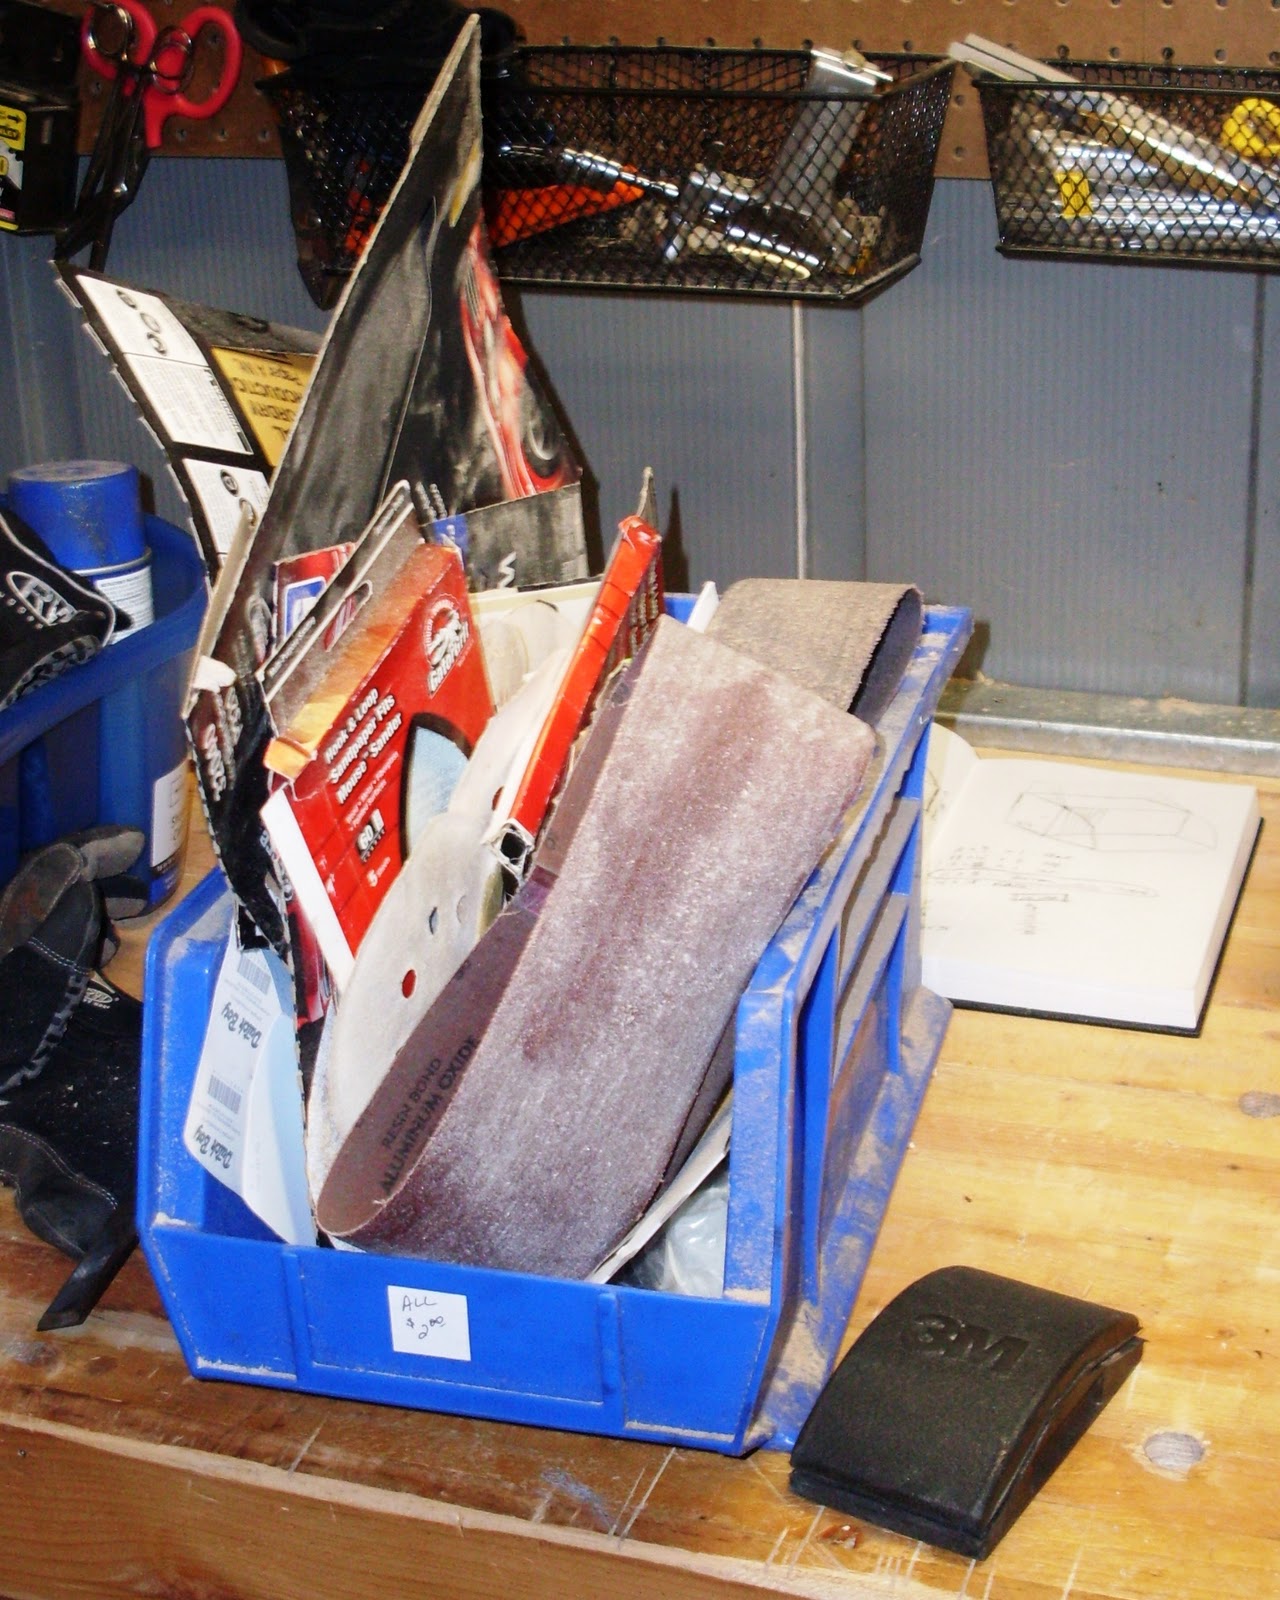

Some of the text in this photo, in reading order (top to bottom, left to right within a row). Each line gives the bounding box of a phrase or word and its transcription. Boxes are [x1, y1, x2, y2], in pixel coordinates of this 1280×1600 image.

[325, 688, 378, 764] Hook & Loop
[329, 694, 395, 784] Sandpaper Fits
[368, 712, 402, 758] Sander
[221, 1001, 263, 1049] Dutch Boy
[382, 1058, 441, 1148] RESIN BOND
[194, 1124, 233, 1170] Dutch Boy
[380, 1093, 443, 1197] ALUMINUM
[402, 1294, 438, 1312] ALL
[913, 1314, 1029, 1374] 3M
